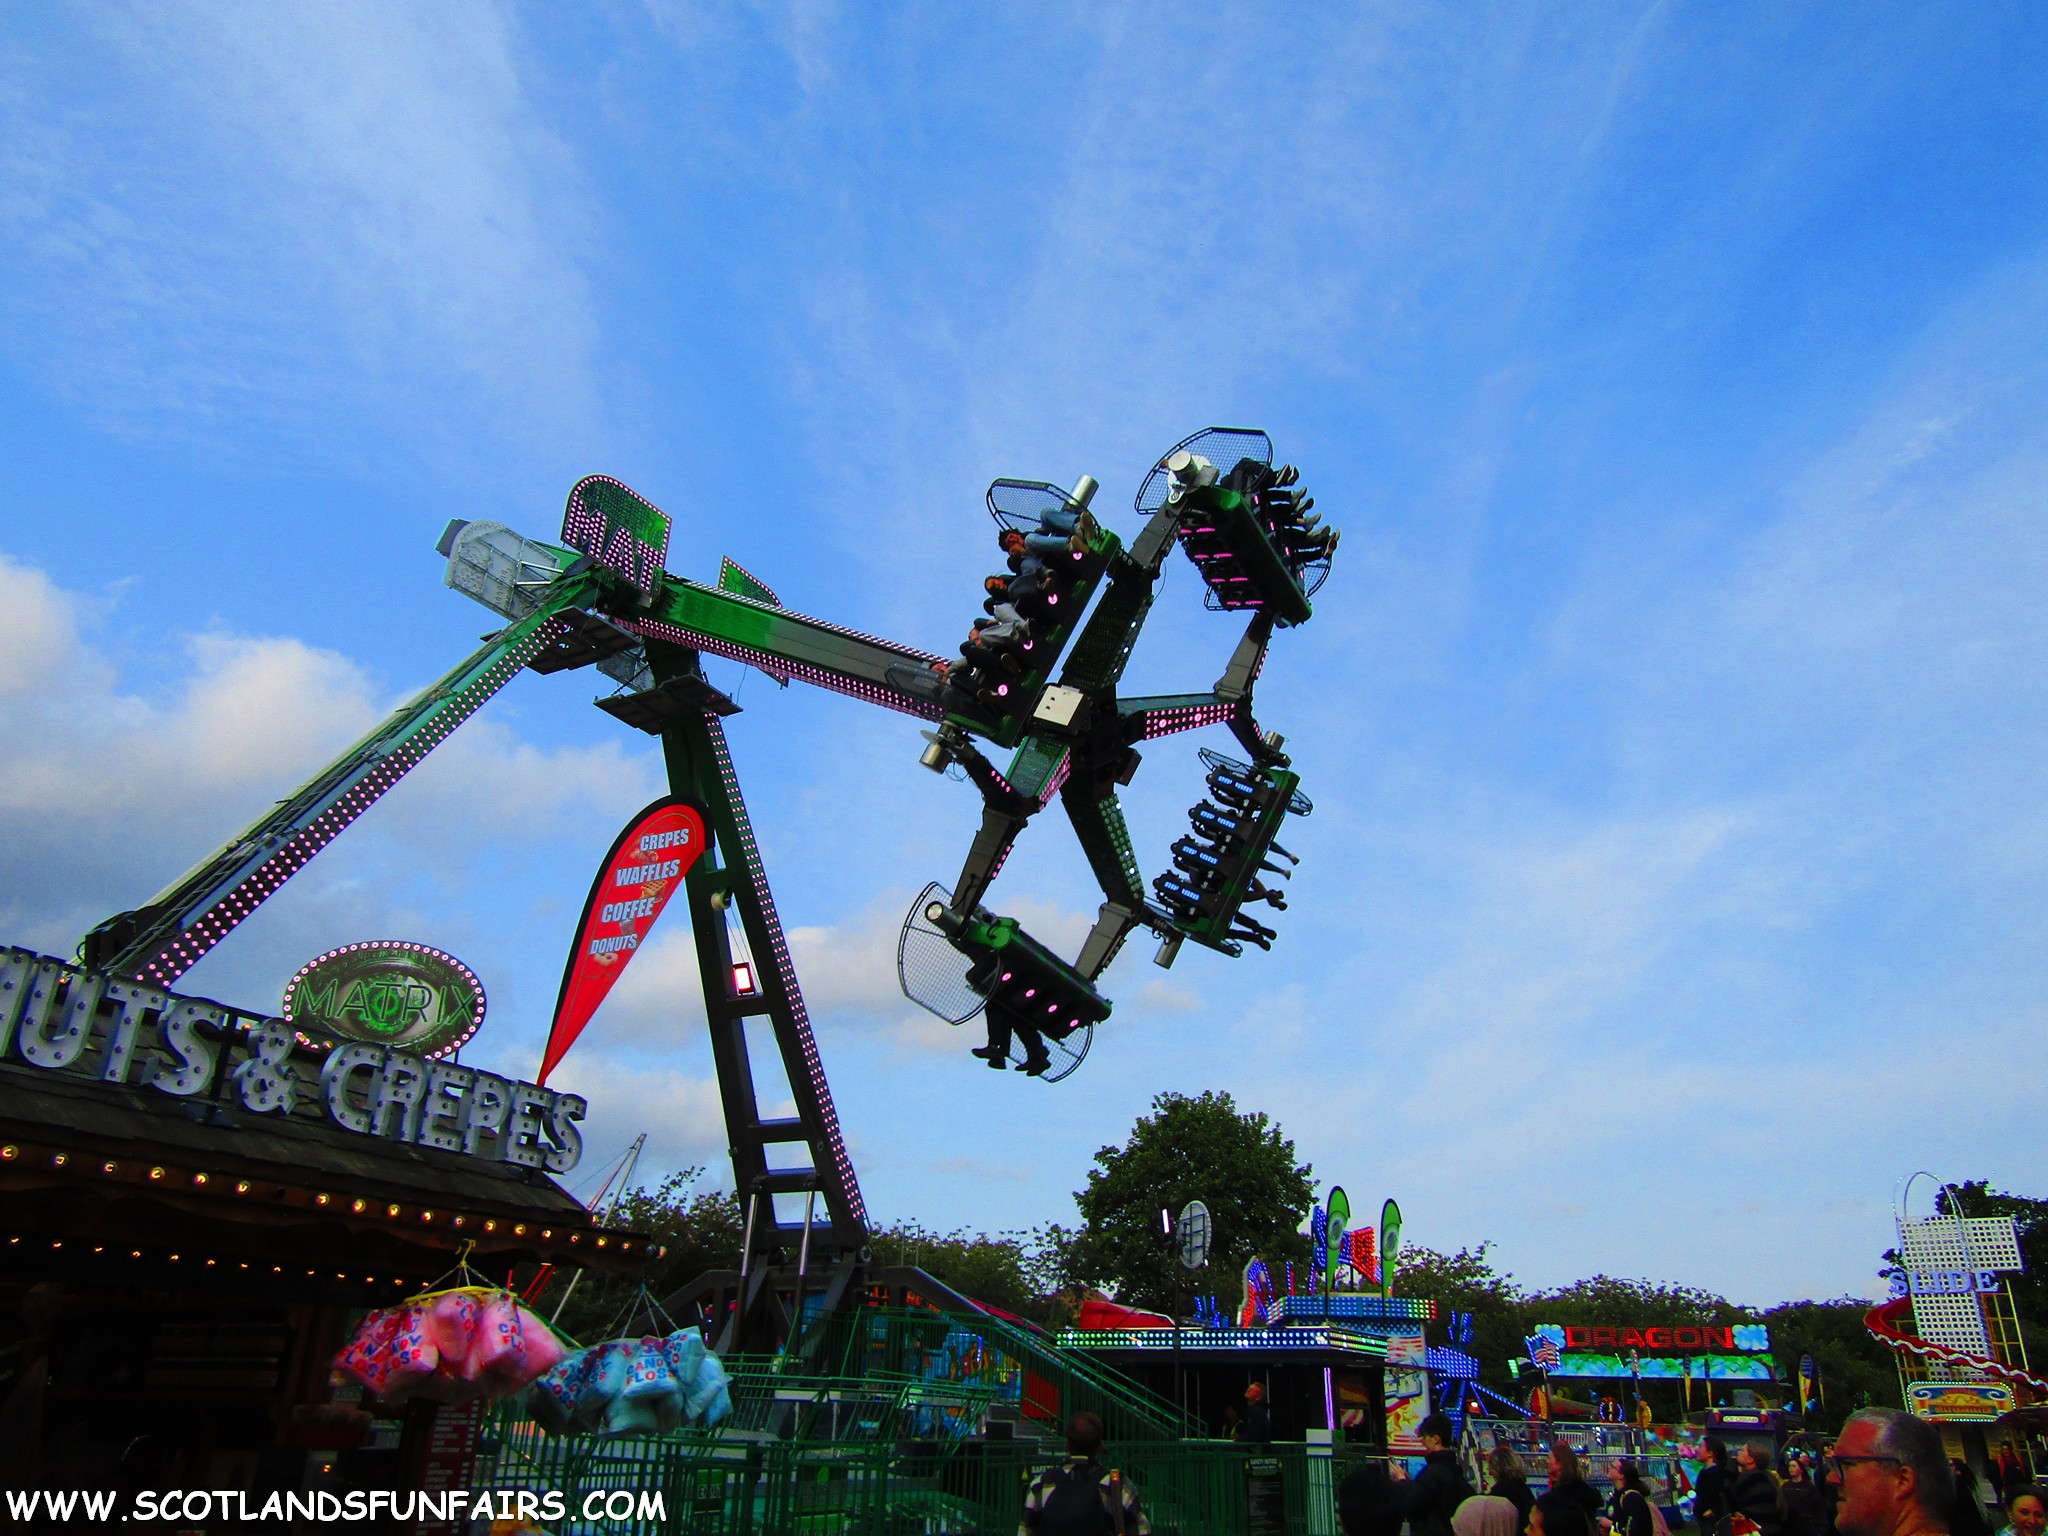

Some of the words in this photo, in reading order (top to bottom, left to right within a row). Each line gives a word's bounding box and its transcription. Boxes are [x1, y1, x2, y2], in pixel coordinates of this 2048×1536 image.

[640, 828, 690, 852] CREPES
[616, 859, 681, 887] WAFFLES
[601, 897, 656, 924] COFFEE
[590, 933, 639, 955] DONUTS
[295, 976, 479, 1026] MATRIX
[232, 1017, 300, 1116] &
[319, 1042, 589, 1176] CREPES
[1888, 1269, 2000, 1297] SLIDE
[1565, 1326, 1734, 1349] DRAGON
